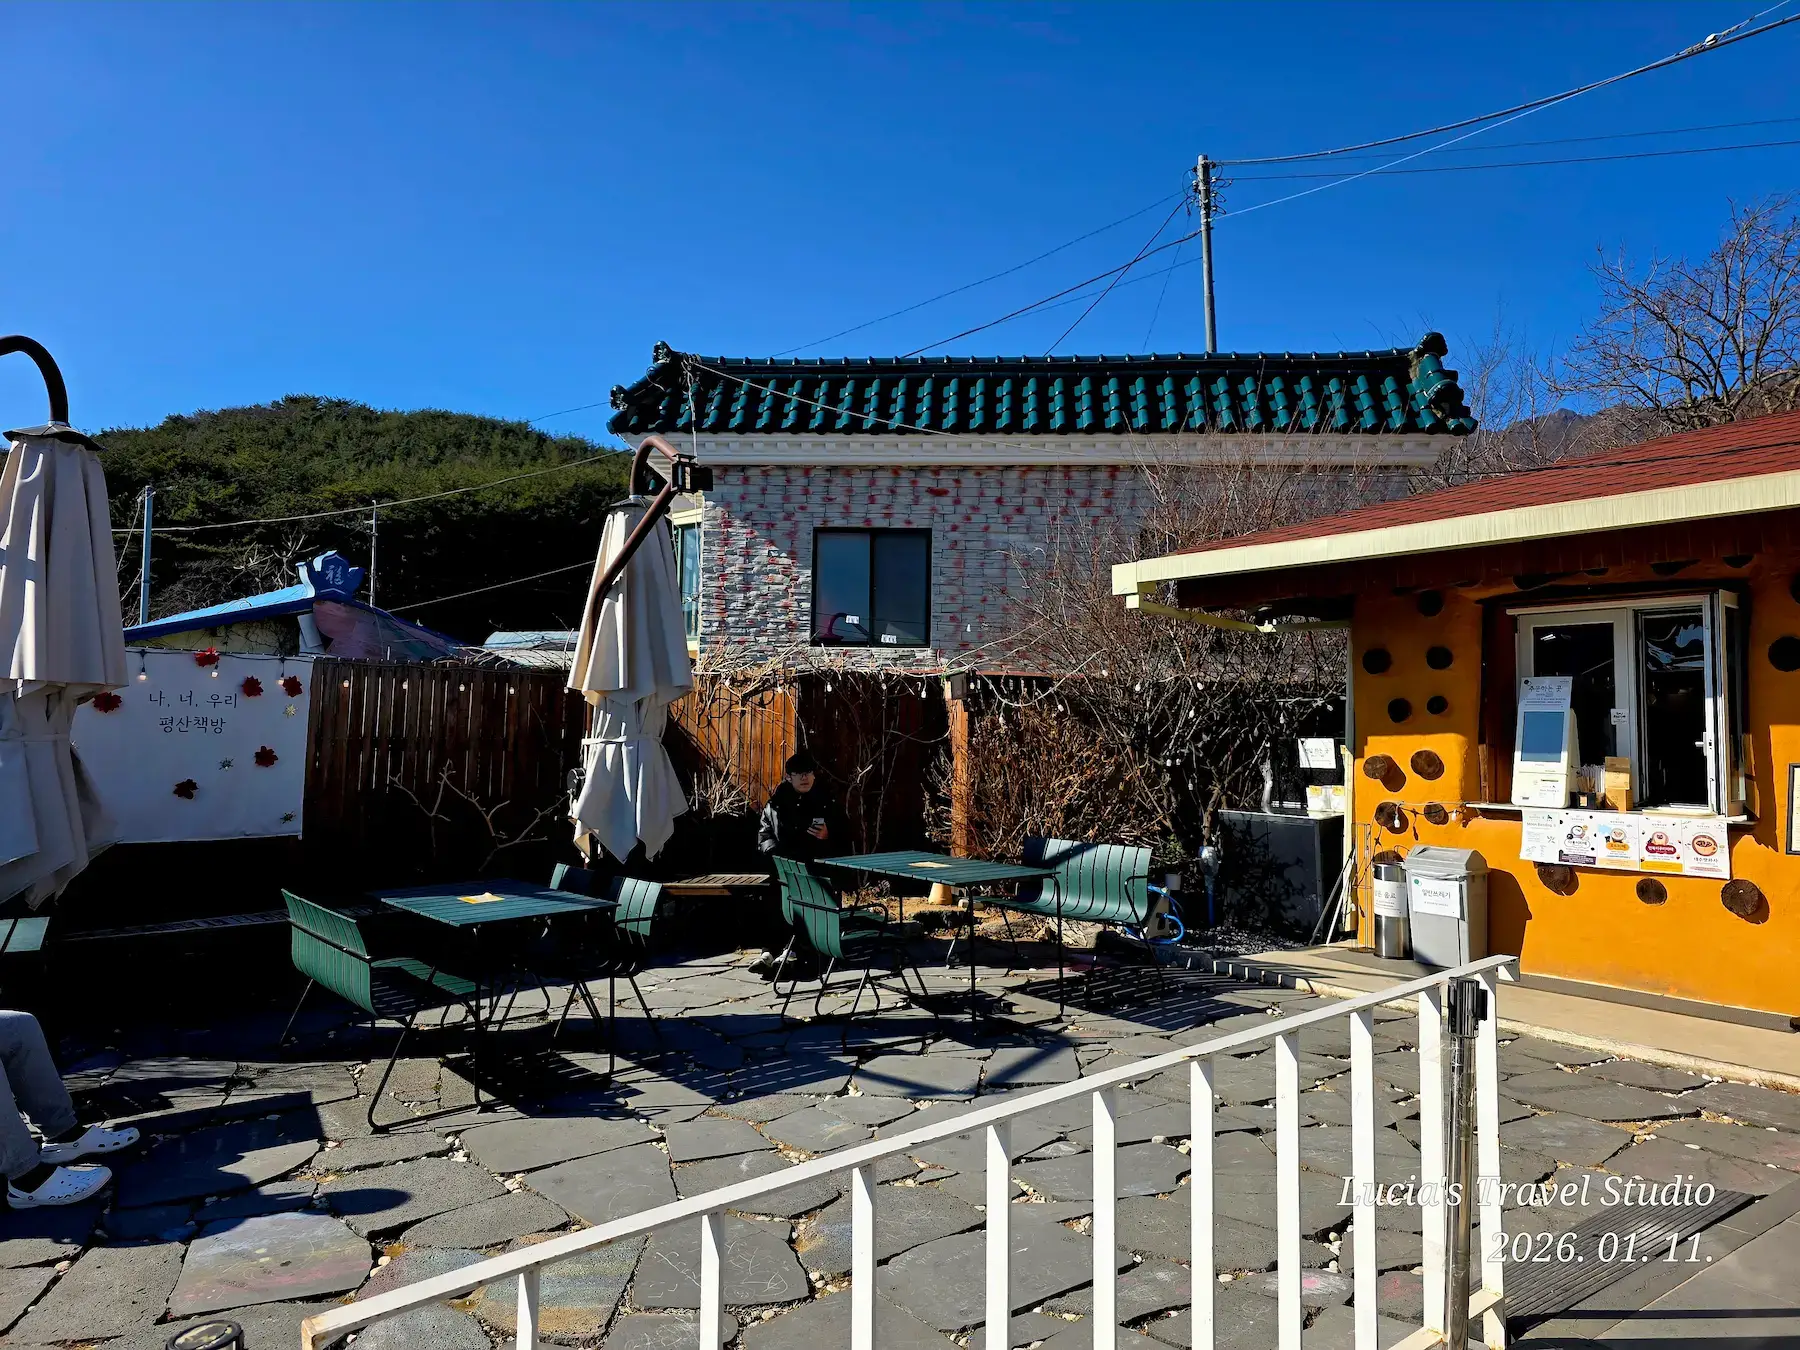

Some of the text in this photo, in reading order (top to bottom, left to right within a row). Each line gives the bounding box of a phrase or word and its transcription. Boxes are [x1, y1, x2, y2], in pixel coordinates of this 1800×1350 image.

[148, 690, 238, 709] 나, 너, 우리
[158, 716, 227, 734] 평산책방
[1421, 888, 1451, 899] 일반쓰레기
